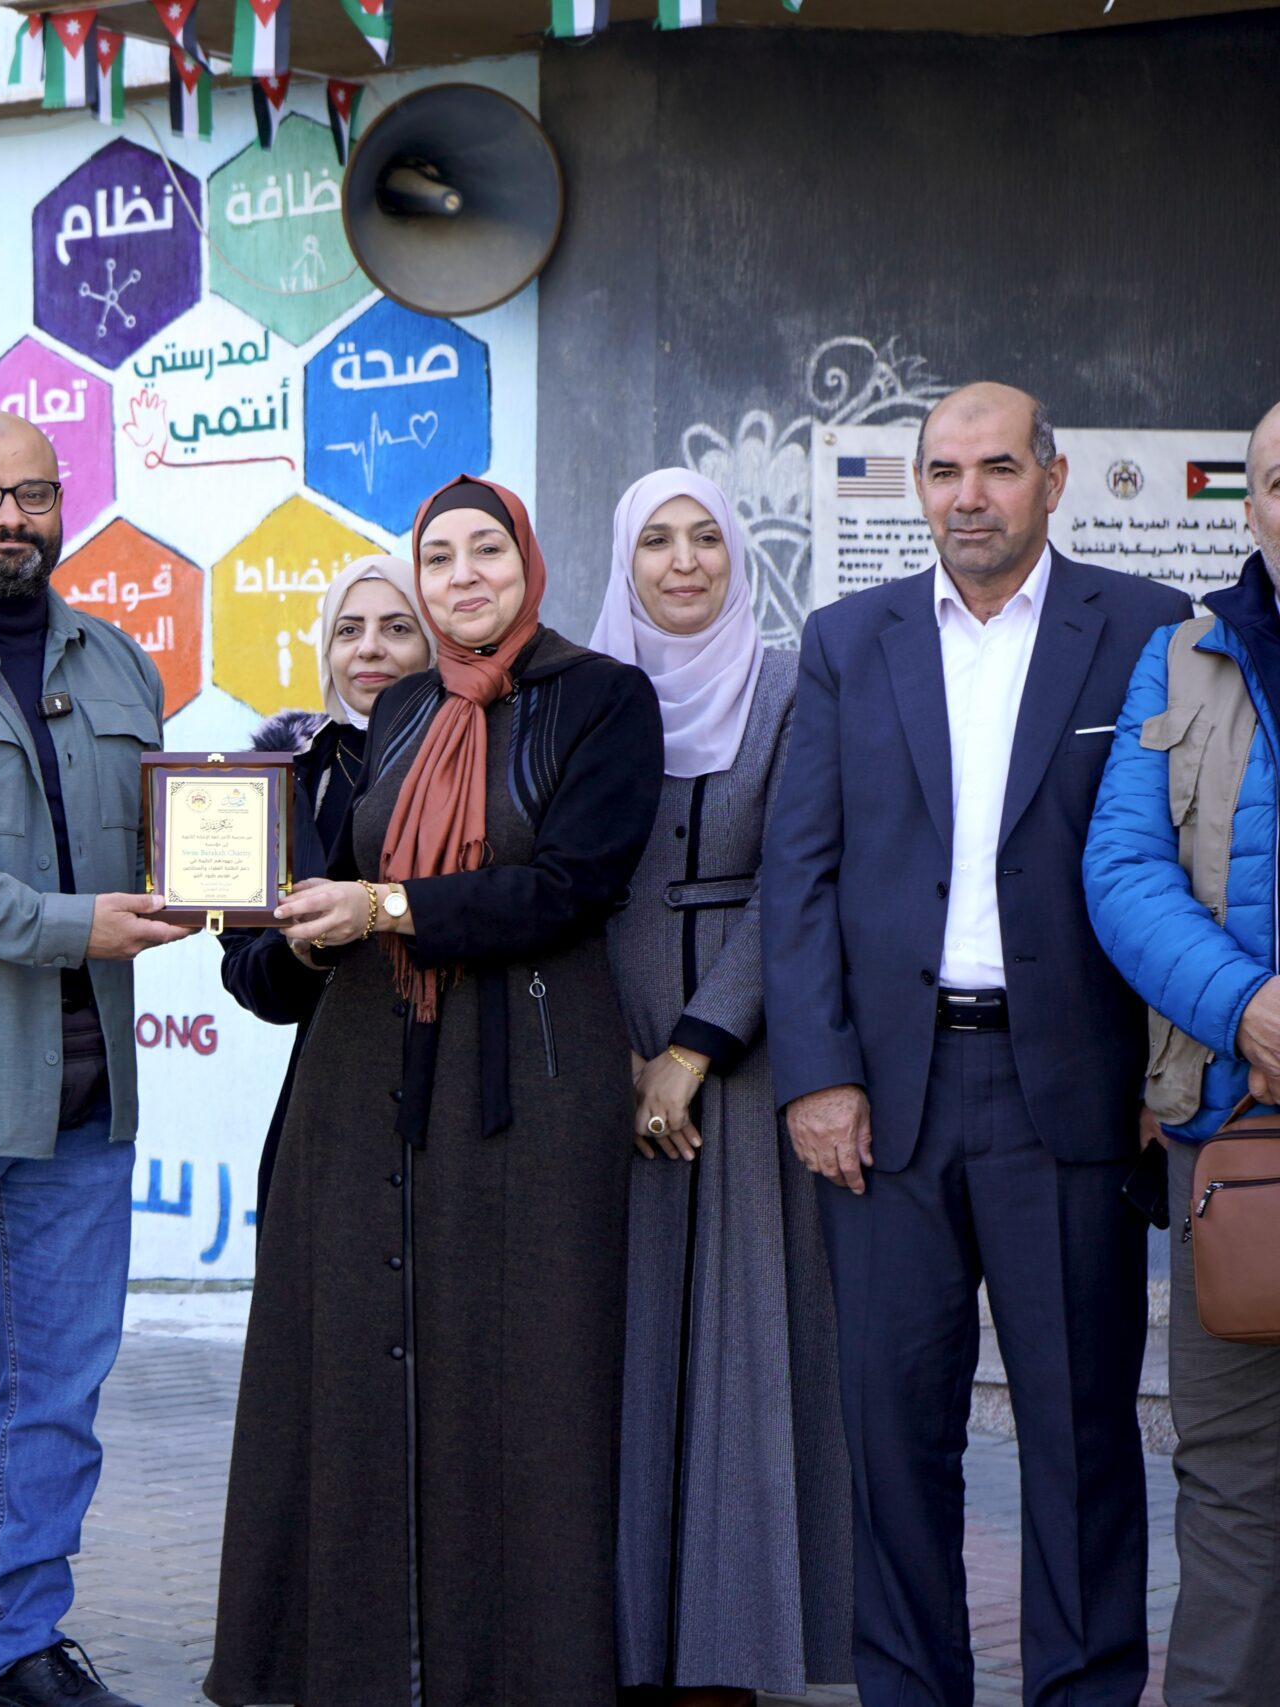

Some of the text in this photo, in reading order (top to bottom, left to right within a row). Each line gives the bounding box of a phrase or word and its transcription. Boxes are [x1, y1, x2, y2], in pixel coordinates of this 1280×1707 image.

[226, 168, 342, 225] ظافة
[56, 185, 174, 265] نظام
[133, 329, 270, 389] لمدرستي
[331, 338, 459, 391] صحة
[168, 378, 290, 454] أنتمي
[838, 517, 928, 526] The constructio
[1072, 517, 1087, 531] من
[1129, 516, 1170, 532] المدرسة
[1177, 517, 1199, 530] هذه
[1206, 517, 1237, 533] إنشاء
[863, 532, 901, 540] made
[907, 533, 933, 542] pos
[838, 547, 929, 556] generous grant
[838, 560, 922, 571] Agency for
[234, 552, 352, 602] نضباط
[838, 575, 900, 584] Developm
[1197, 568, 1240, 583] دولية
[64, 563, 172, 612] قواعد
[135, 1013, 219, 1056] ONG
